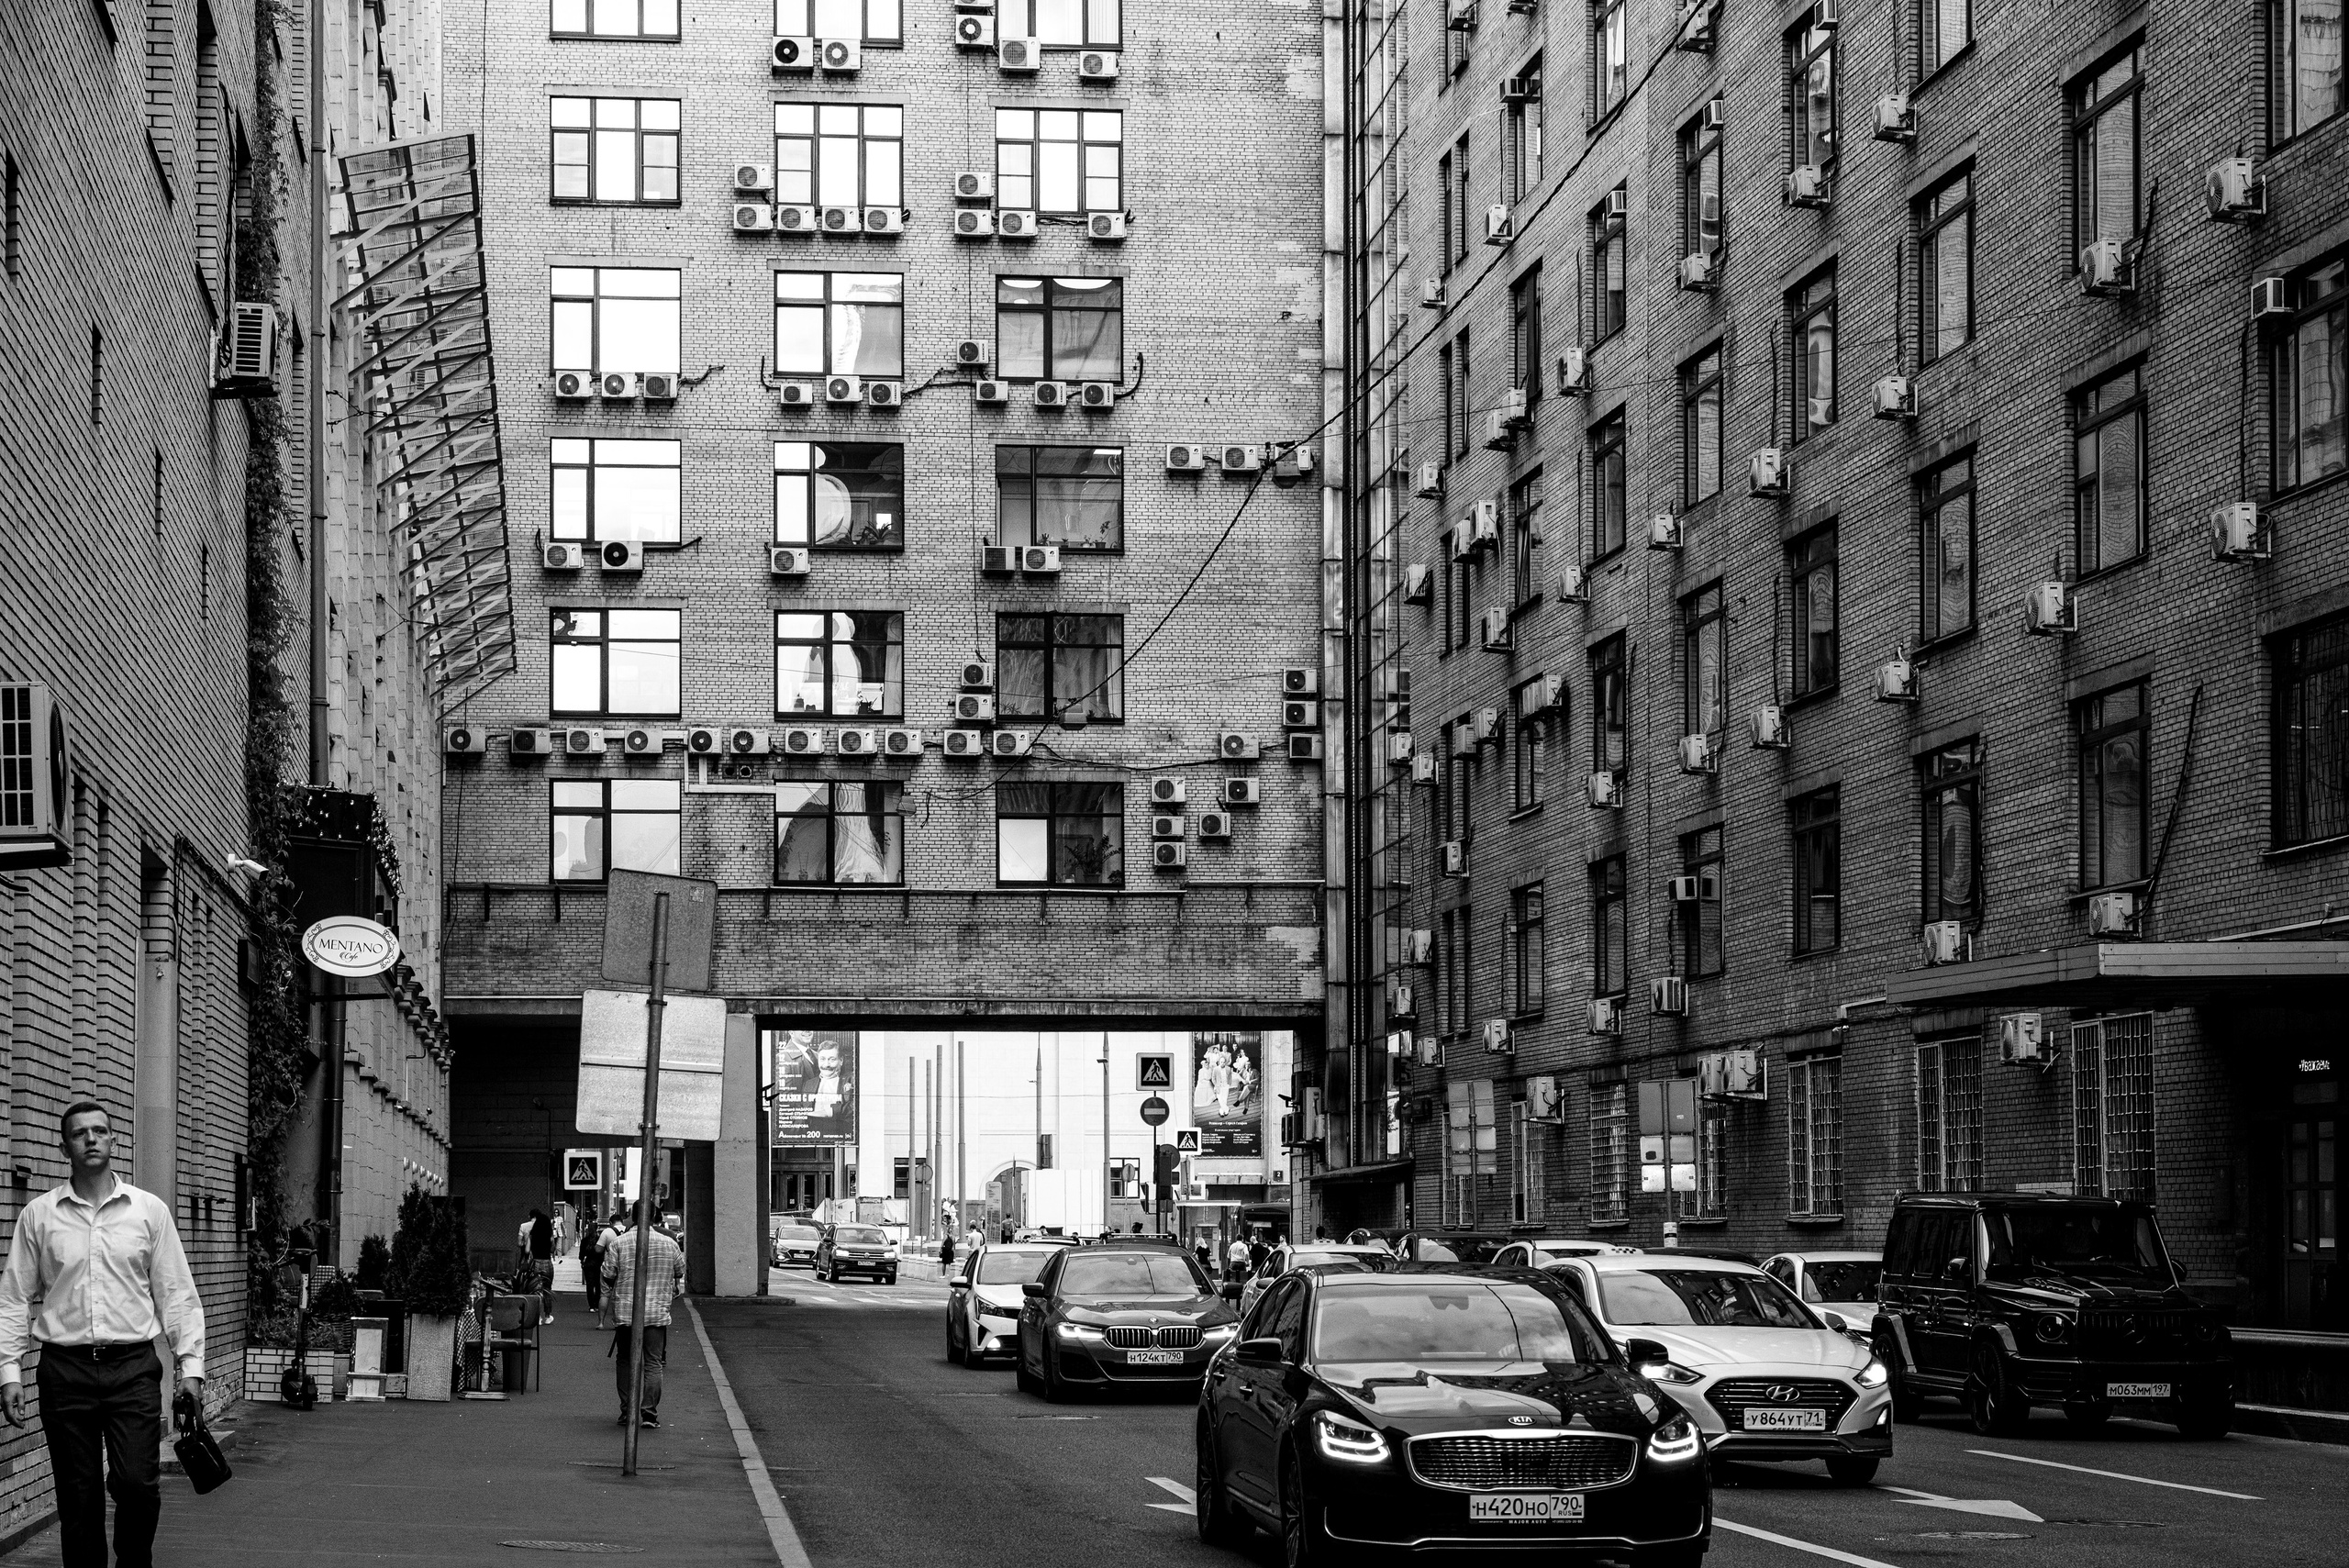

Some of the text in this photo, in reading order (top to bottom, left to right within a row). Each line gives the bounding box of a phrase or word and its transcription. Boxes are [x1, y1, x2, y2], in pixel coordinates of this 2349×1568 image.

[318, 939, 384, 954] MENTANO
[778, 1094, 802, 1102] СКАЗКИ
[802, 1094, 807, 1102] С
[807, 1130, 821, 1139] 200
[2110, 1384, 2168, 1396] М063ММ 197
[1751, 1412, 1820, 1426] У864УТ 71
[1475, 1496, 1579, 1516] Н420НО 790
